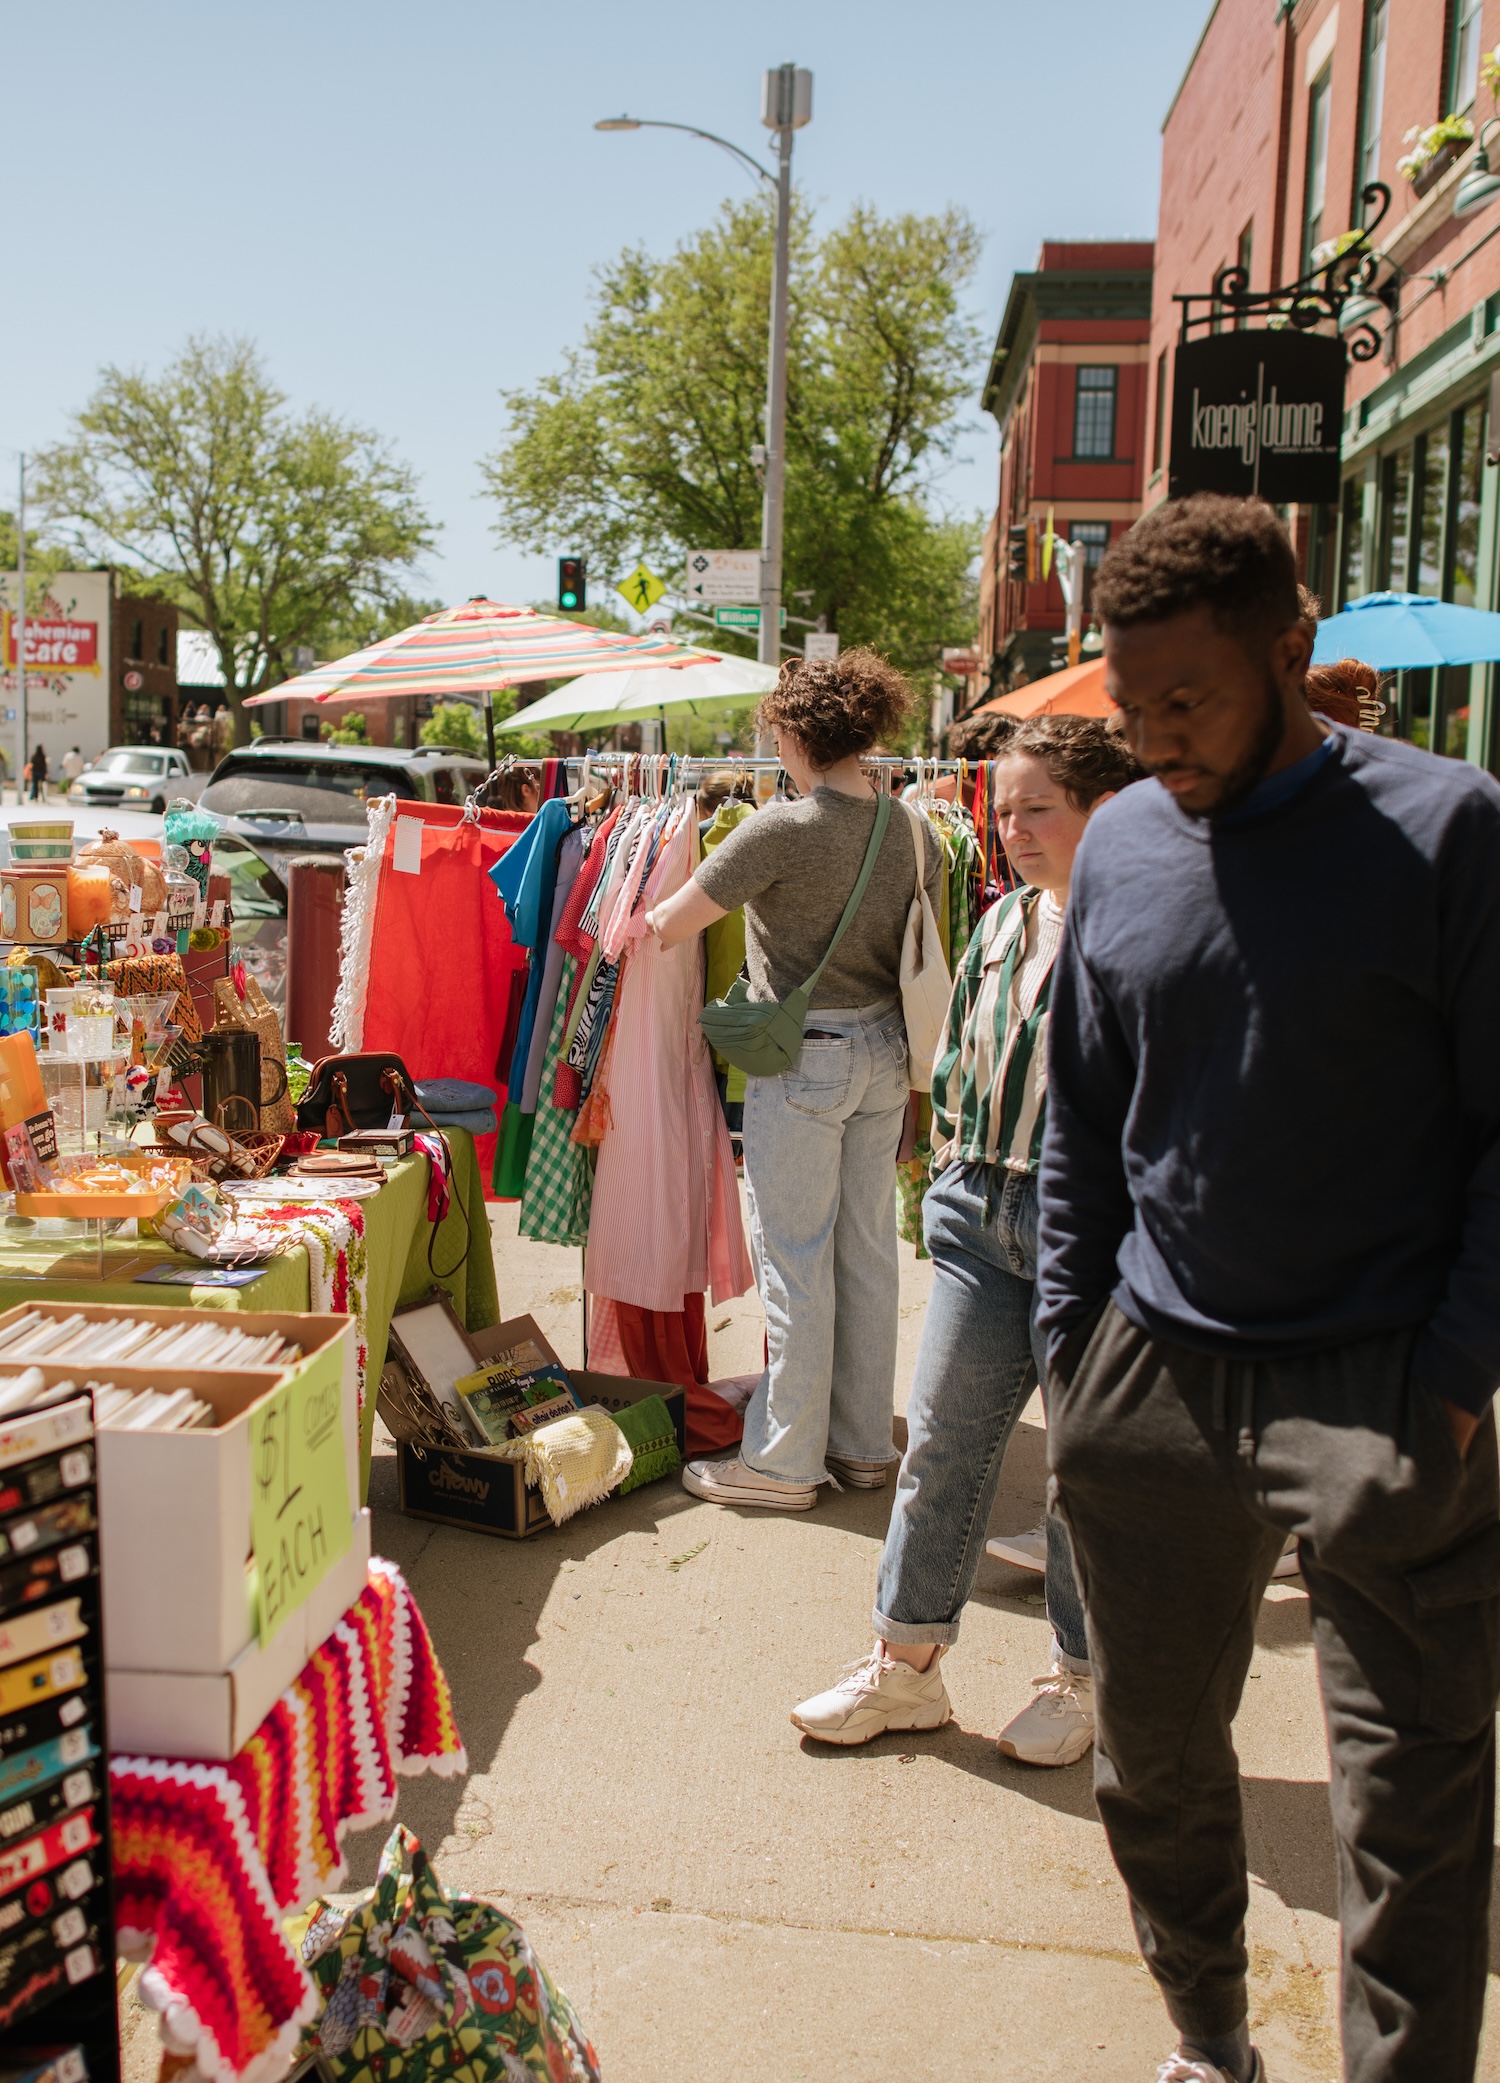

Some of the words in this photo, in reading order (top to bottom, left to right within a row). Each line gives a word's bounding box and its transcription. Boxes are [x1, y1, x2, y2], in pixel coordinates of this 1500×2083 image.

[719, 611, 758, 624] William
[22, 640, 78, 663] Cafe
[44, 1129, 55, 1143] go
[428, 1463, 490, 1500] chewy
[264, 1504, 327, 1626] EACH
